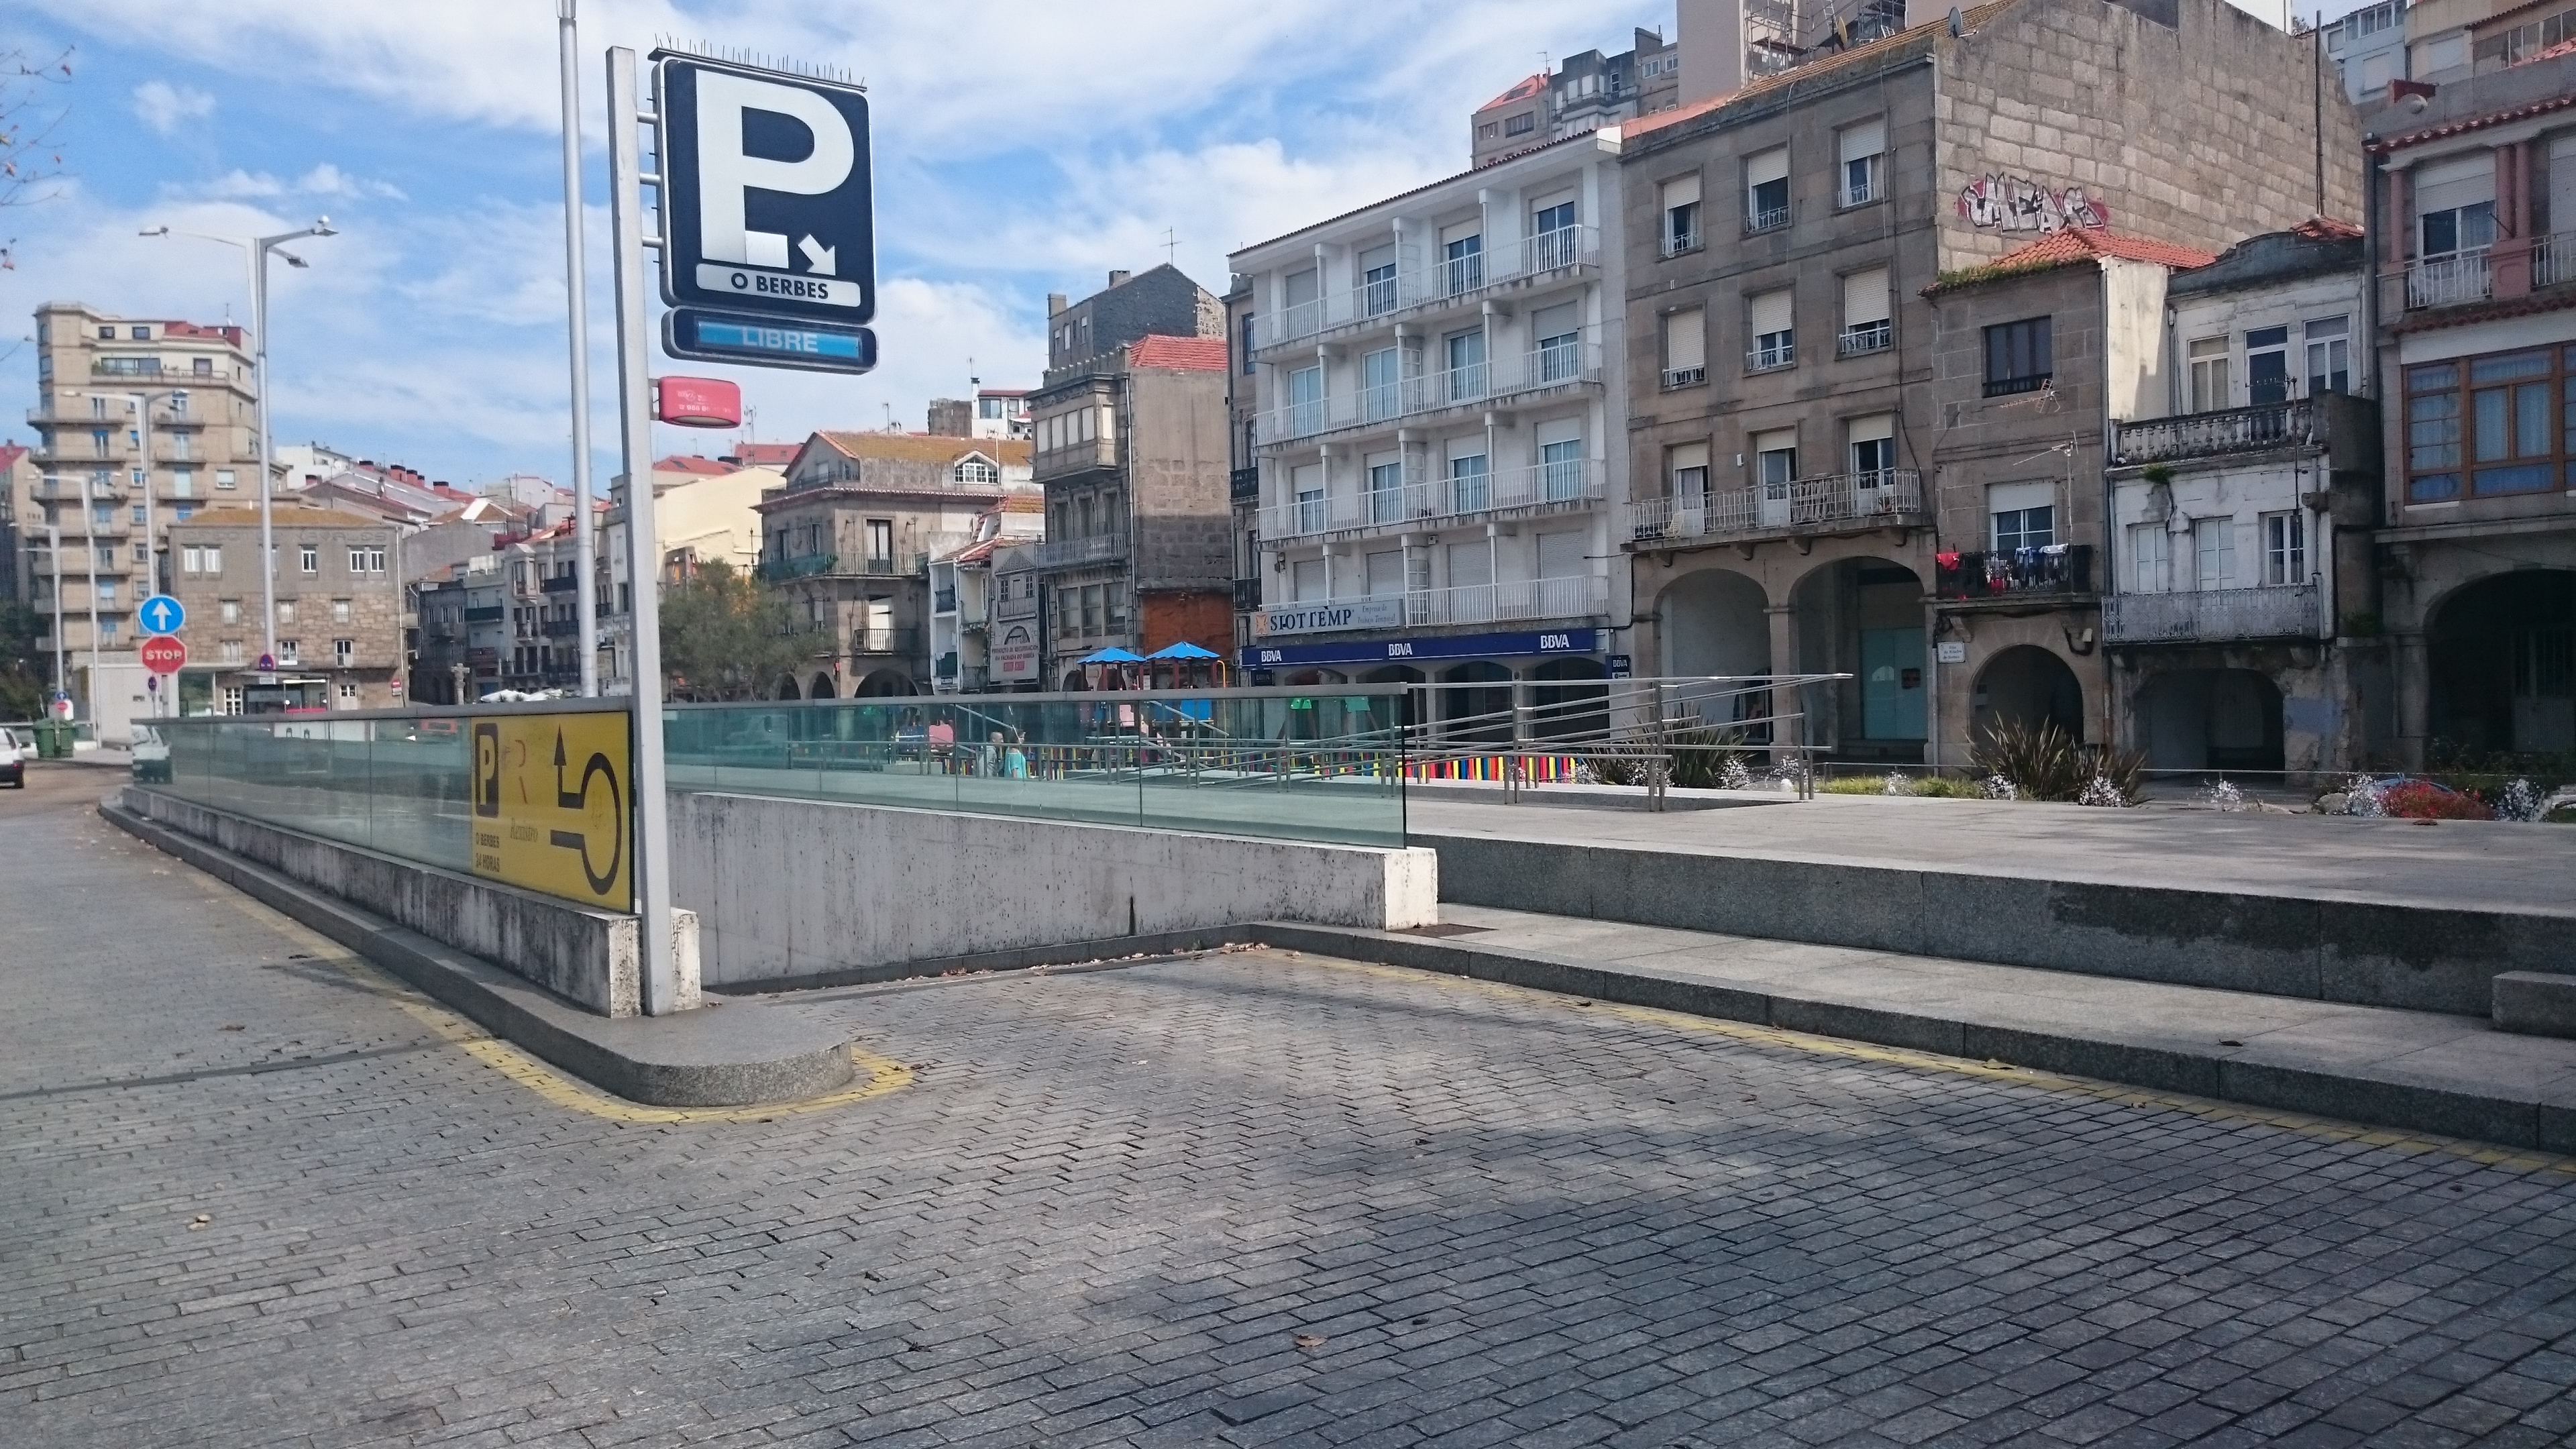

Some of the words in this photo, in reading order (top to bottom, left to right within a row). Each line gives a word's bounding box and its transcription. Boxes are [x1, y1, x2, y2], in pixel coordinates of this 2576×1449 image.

[695, 68, 855, 266] P
[731, 272, 749, 290] O
[756, 275, 829, 299] BERBES
[742, 327, 819, 353] LIBRE
[1540, 634, 1570, 649] BBVA
[146, 649, 182, 661] STOP
[1261, 650, 1282, 662] BBVA
[1388, 643, 1413, 657] BBVA
[1613, 659, 1628, 667] BBVA
[479, 735, 496, 805] P
[480, 833, 500, 849] BERBES
[482, 854, 500, 873] HORAS
